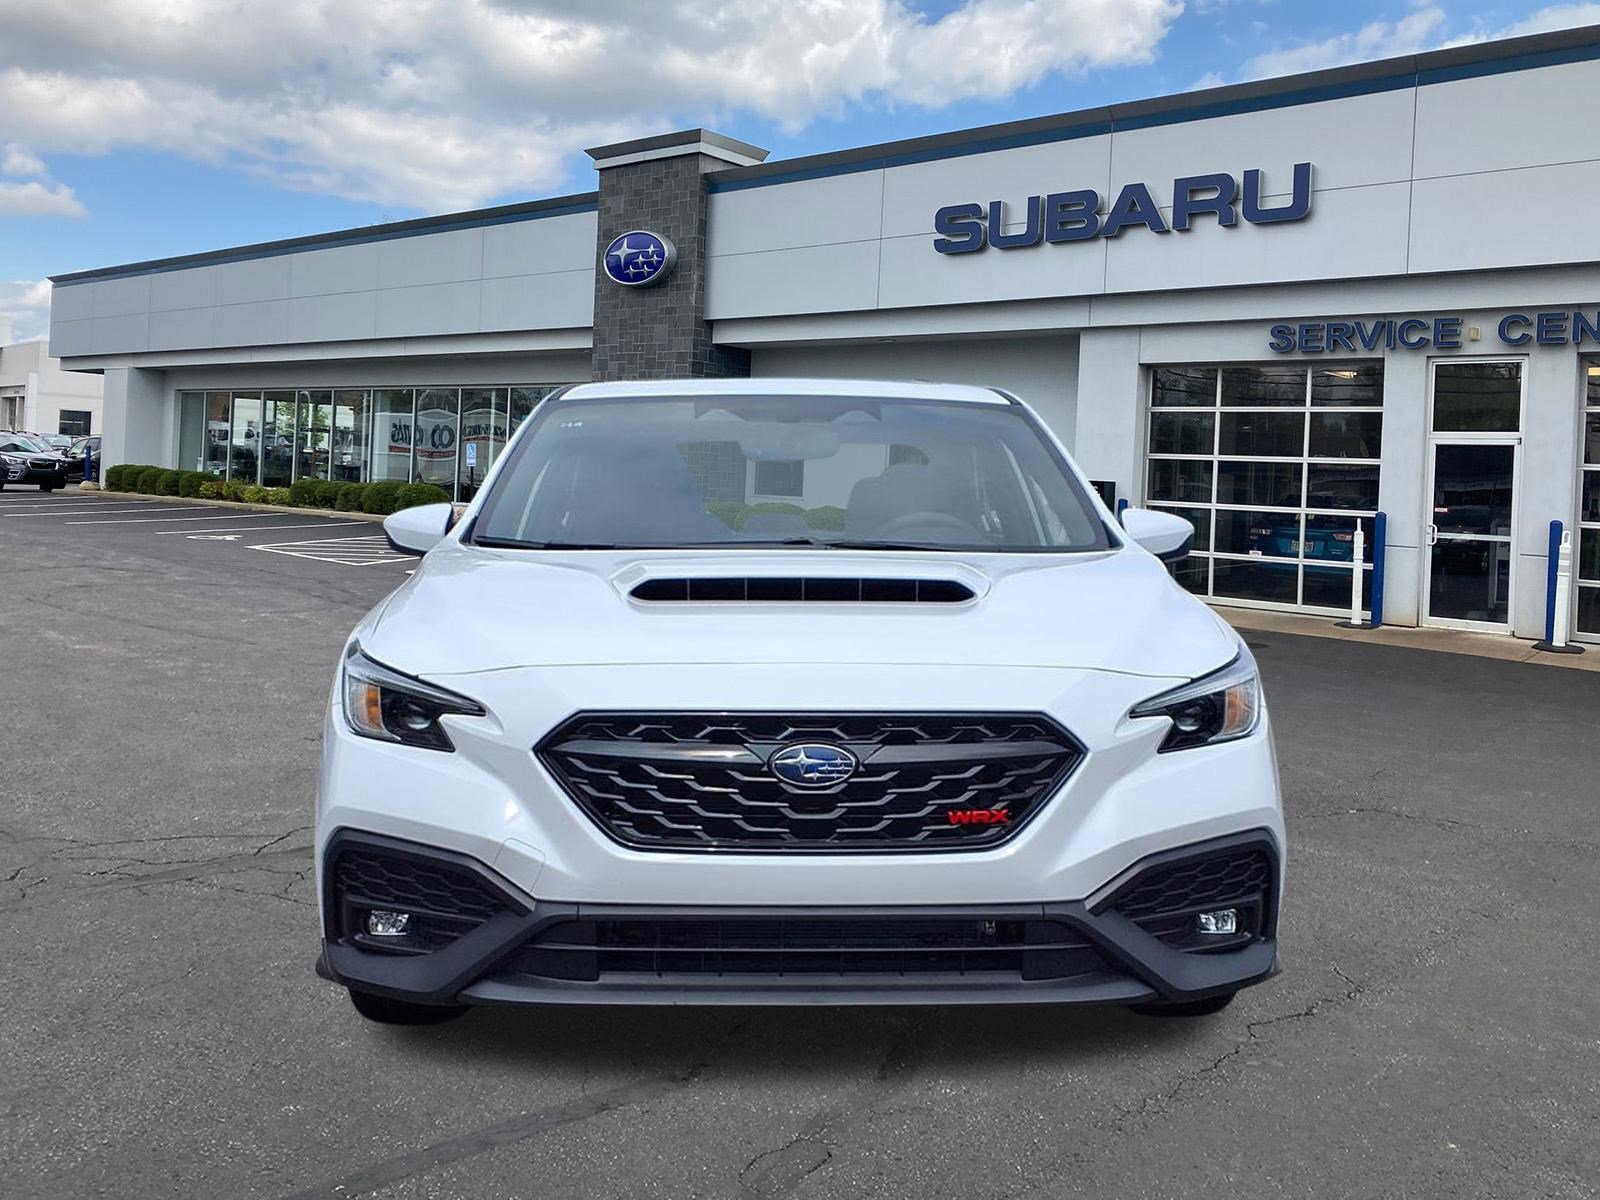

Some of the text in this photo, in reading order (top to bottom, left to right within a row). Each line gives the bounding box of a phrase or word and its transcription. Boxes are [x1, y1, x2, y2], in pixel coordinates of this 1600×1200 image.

[934, 162, 1313, 254] SUBARU
[1269, 317, 1463, 352] SERVICE
[947, 808, 1009, 825] WRX
